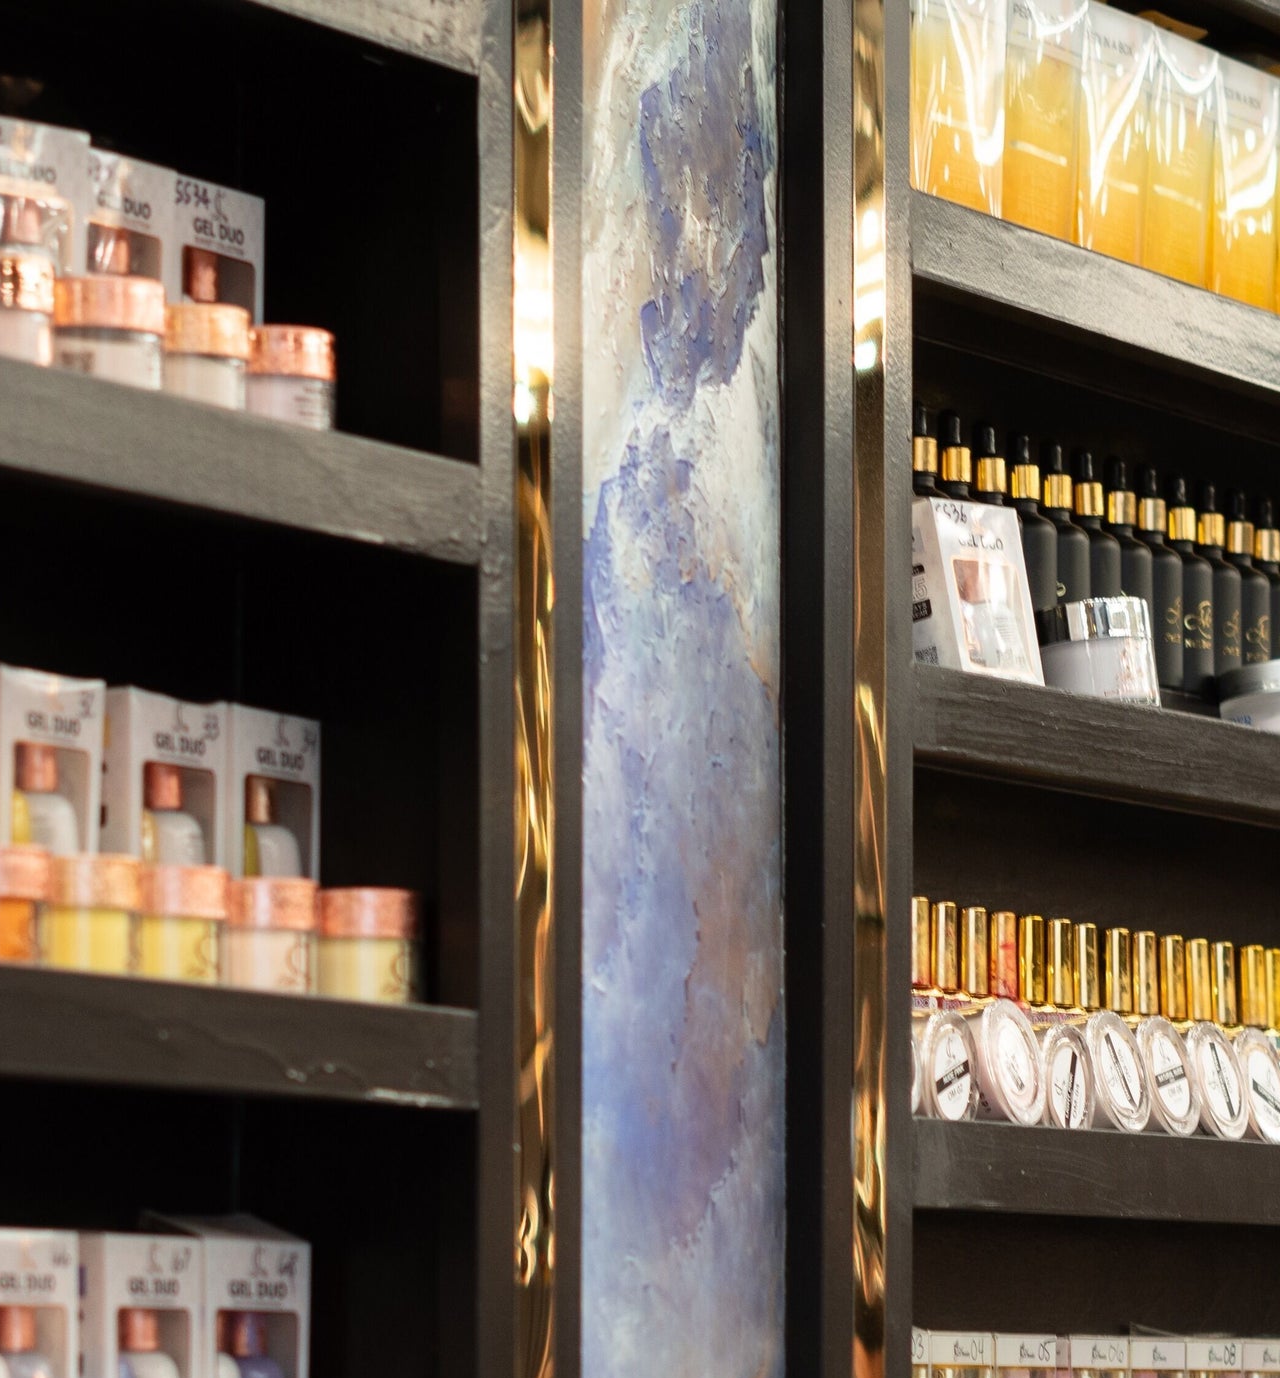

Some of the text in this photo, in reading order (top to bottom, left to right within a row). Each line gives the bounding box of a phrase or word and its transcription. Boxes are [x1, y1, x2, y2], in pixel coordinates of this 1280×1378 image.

[124, 198, 151, 220] DUO
[194, 216, 245, 246] GEL DUO
[971, 1339, 985, 1363] 04
[1038, 1340, 1056, 1363] 05
[1109, 1343, 1125, 1364] 06
[1223, 1346, 1236, 1367] 08
